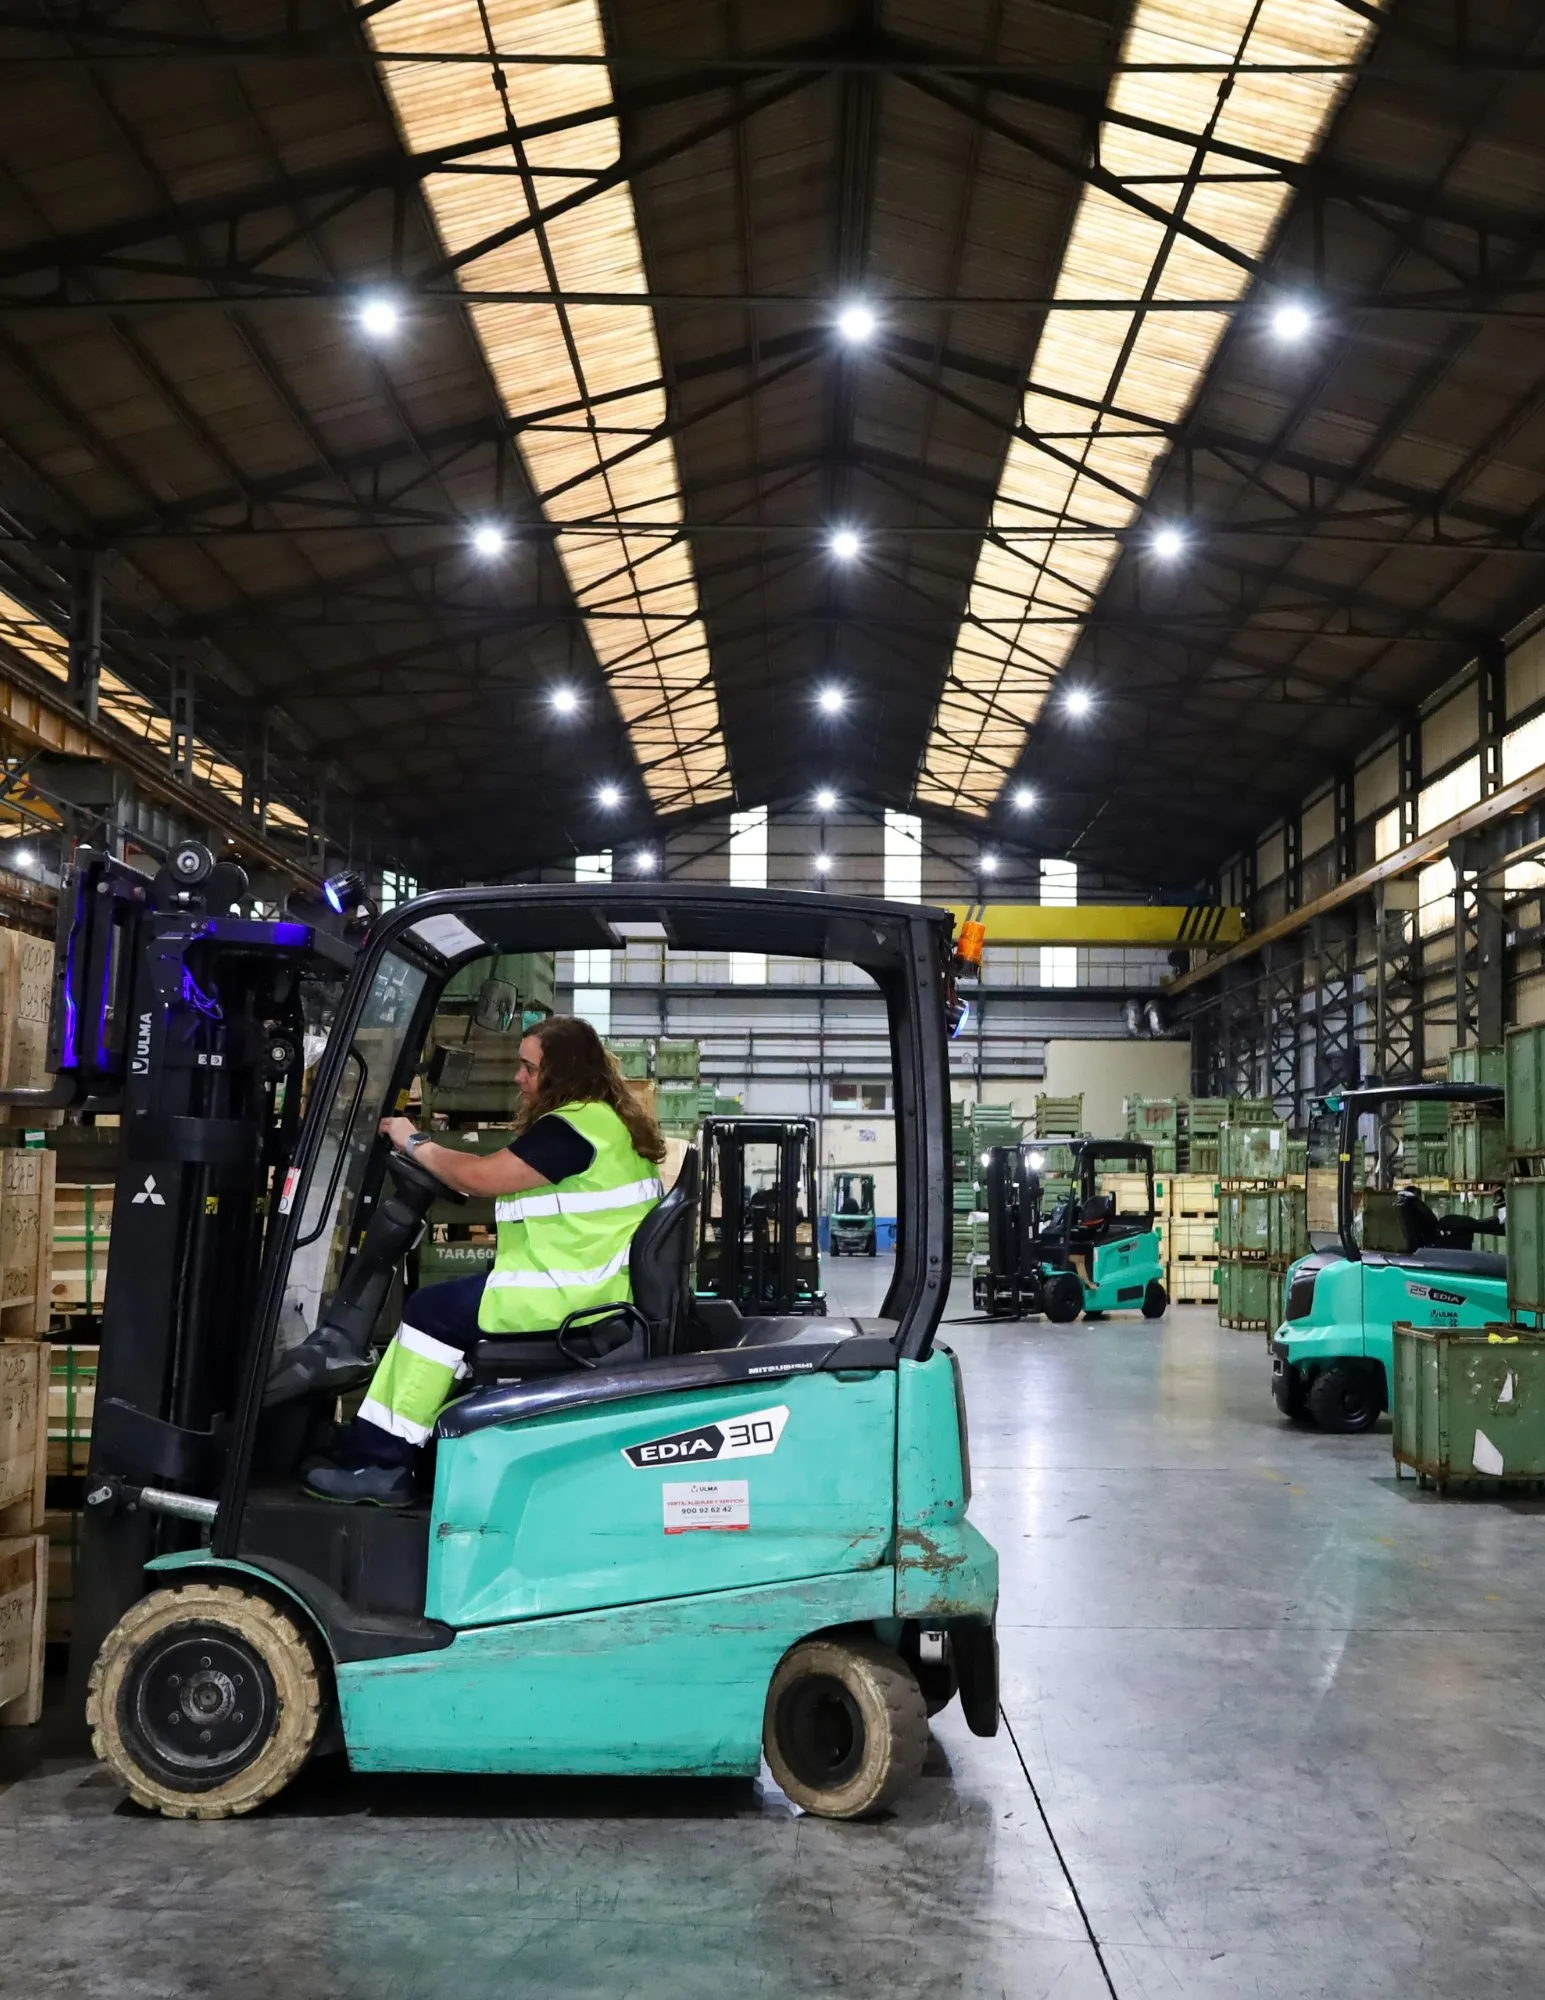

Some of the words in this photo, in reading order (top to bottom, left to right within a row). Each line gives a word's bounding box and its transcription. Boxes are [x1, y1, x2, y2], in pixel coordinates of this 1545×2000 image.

[136, 1011, 153, 1055] ULMA
[748, 1362, 813, 1375] MITSUBISHI
[728, 1420, 774, 1448] 30
